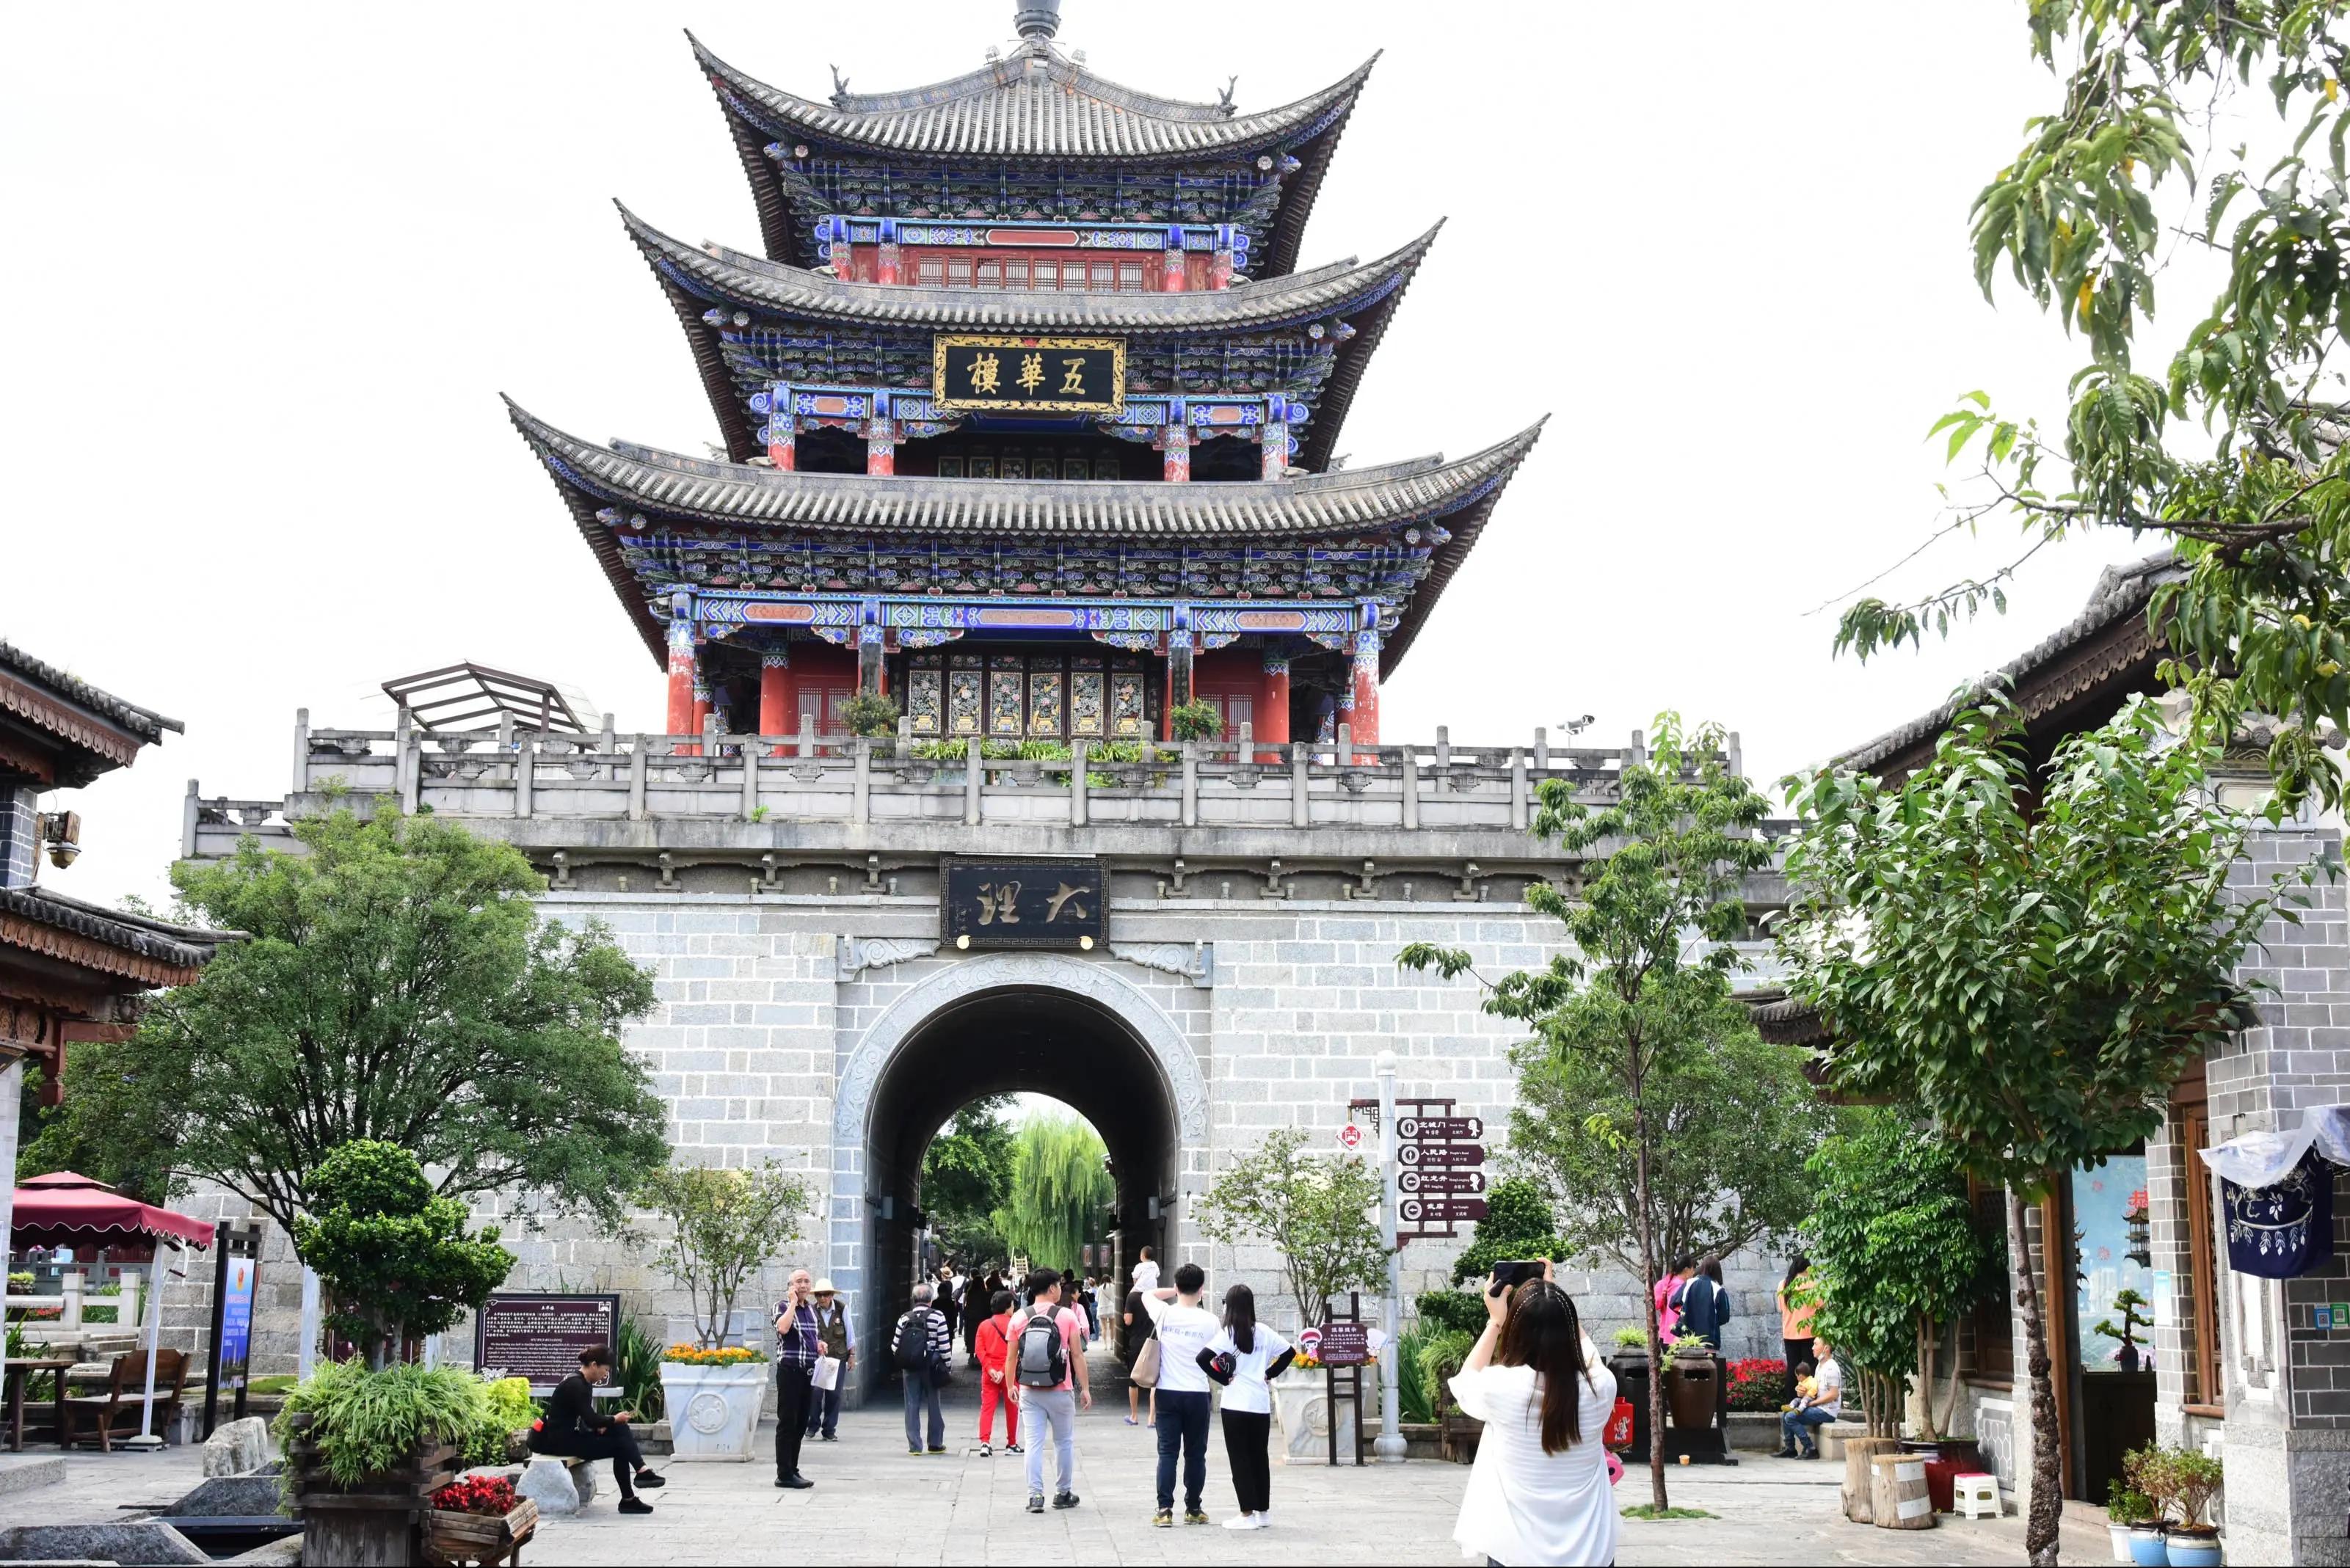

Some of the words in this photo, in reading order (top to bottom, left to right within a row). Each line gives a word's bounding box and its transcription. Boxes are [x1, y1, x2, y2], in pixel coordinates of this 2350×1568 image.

[967, 351, 1087, 396] 五華樓
[976, 880, 1091, 926] 大理
